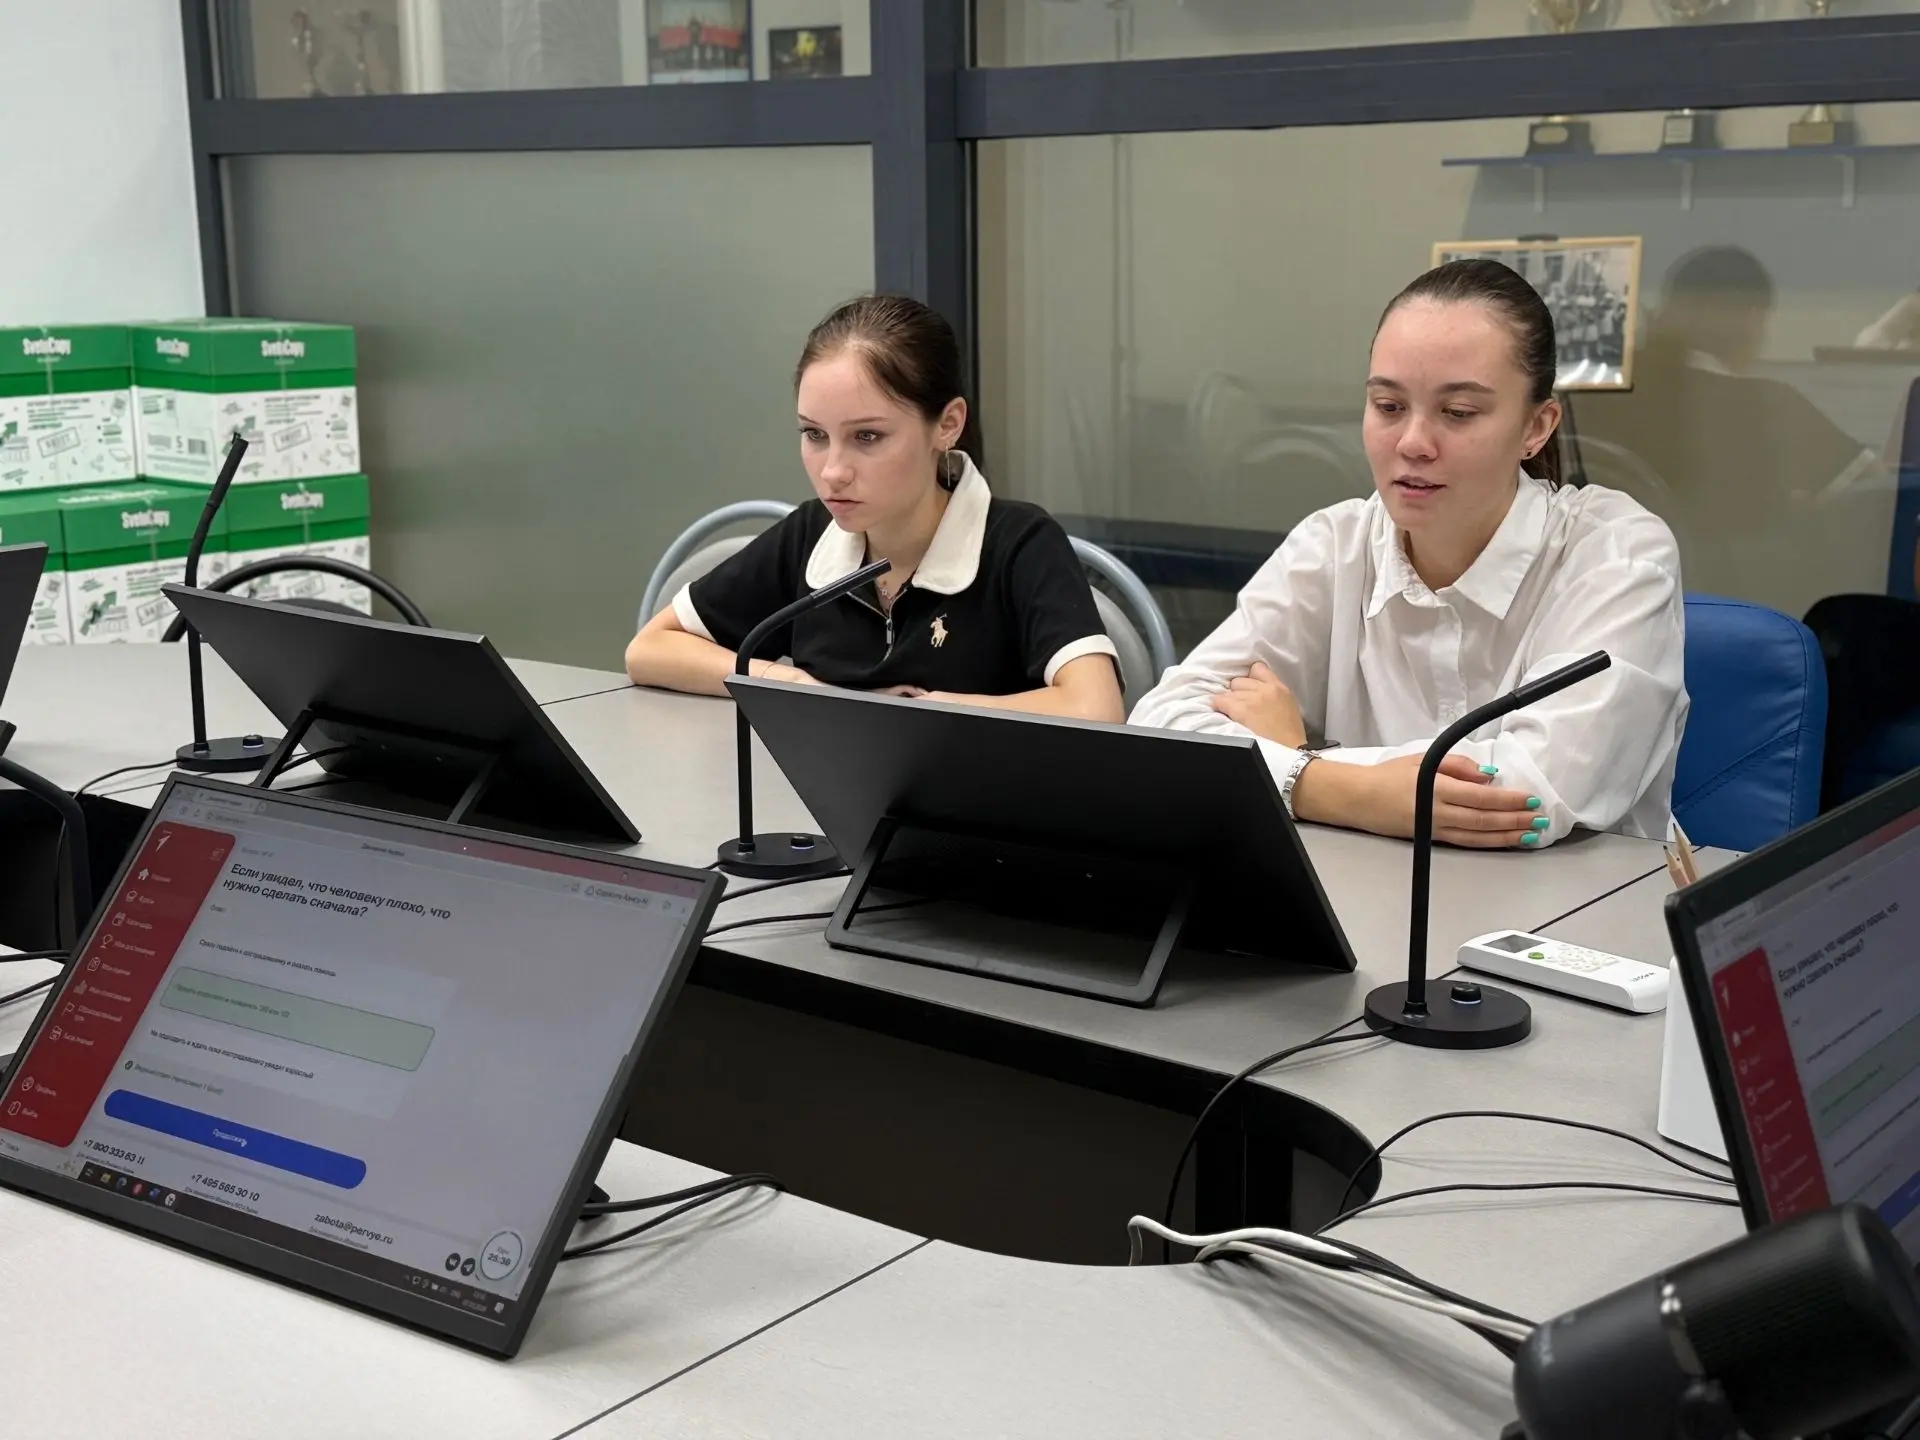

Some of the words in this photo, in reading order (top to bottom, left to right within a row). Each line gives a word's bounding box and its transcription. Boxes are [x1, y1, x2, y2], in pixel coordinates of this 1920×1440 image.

[223, 879, 260, 895] нужно
[261, 888, 308, 906] сделать
[310, 898, 369, 918] сначала?
[231, 864, 259, 878] Если
[260, 871, 304, 889] увидел,
[308, 881, 328, 893] что
[329, 887, 386, 907] человеку
[385, 899, 427, 917] плохо,
[430, 907, 451, 920] что
[92, 1142, 109, 1153] 800
[108, 1147, 125, 1158] 333
[191, 1173, 201, 1183] +7
[201, 1176, 218, 1188] 495
[236, 1187, 248, 1197] 30
[249, 1191, 260, 1201] 10
[314, 1213, 393, 1244] zabota@pervye.ru
